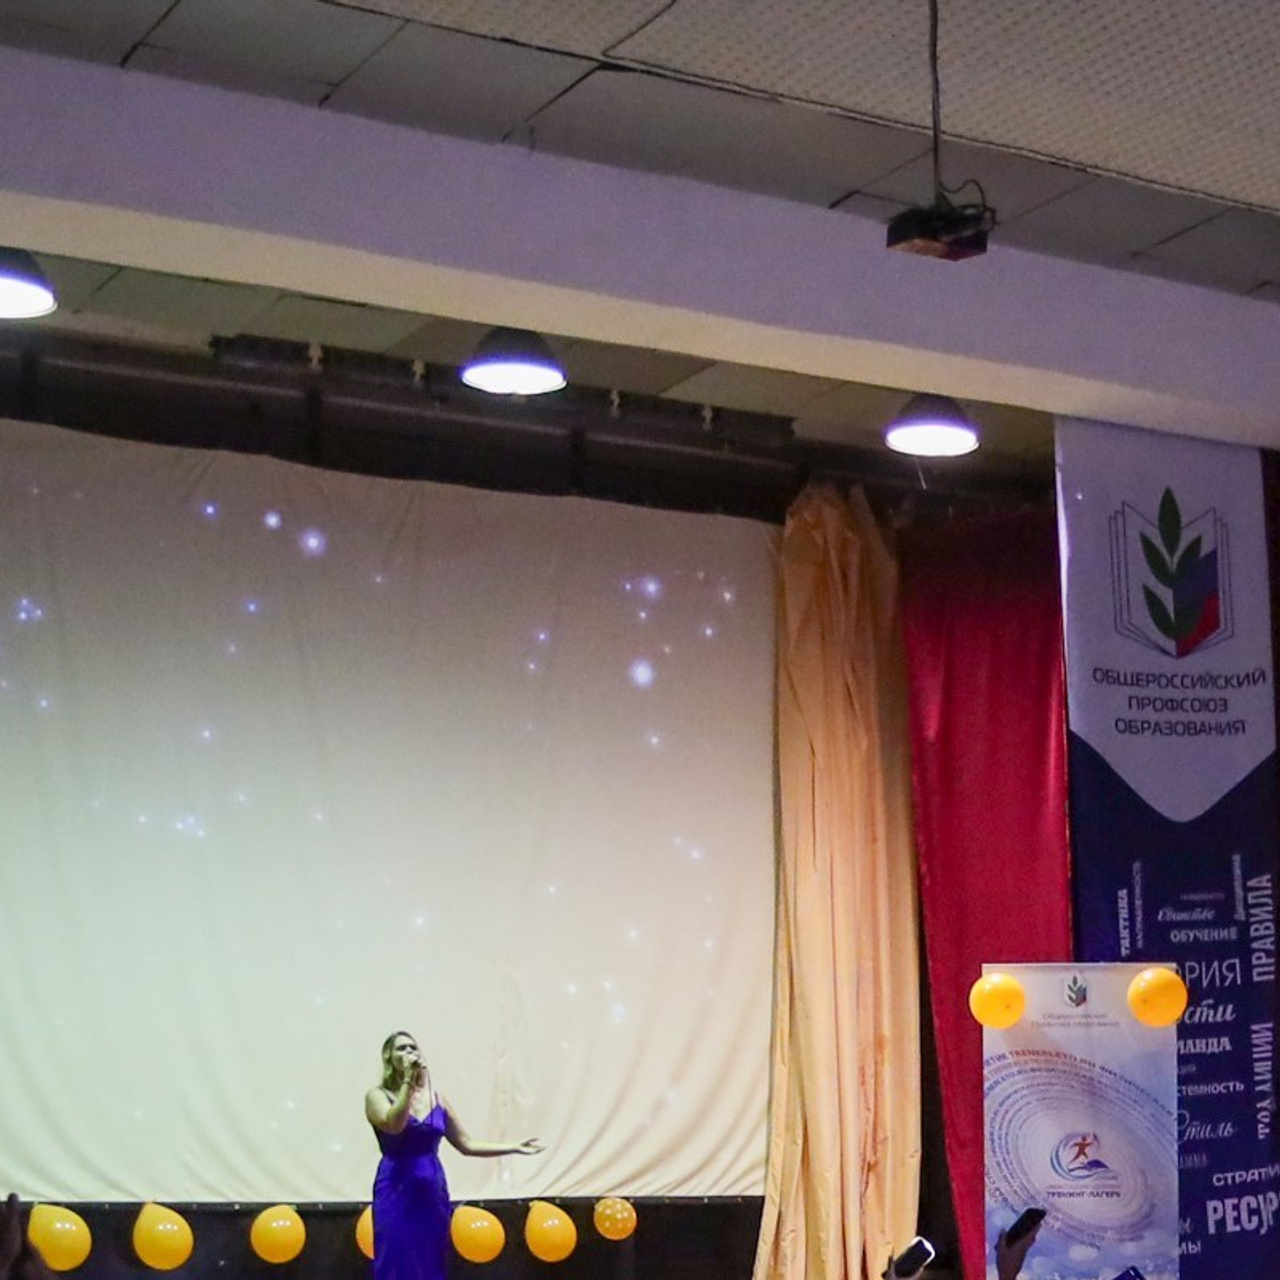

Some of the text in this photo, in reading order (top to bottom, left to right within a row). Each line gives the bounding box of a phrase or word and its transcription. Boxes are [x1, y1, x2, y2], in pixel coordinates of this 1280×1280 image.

[1093, 666, 1267, 690] ОБЩЕРОССИЙСКИЙ
[1127, 696, 1228, 713] ПРОФСОЮЗ
[1114, 718, 1246, 737] ОБРАЗОВАНИЯ
[1117, 888, 1130, 957] ТАКТИКА
[1170, 926, 1239, 943] ОБУЧЕНИЕ
[1247, 873, 1275, 982] ПРАВИЛА
[1179, 958, 1242, 988] РИЯ
[1180, 998, 1237, 1024] сти
